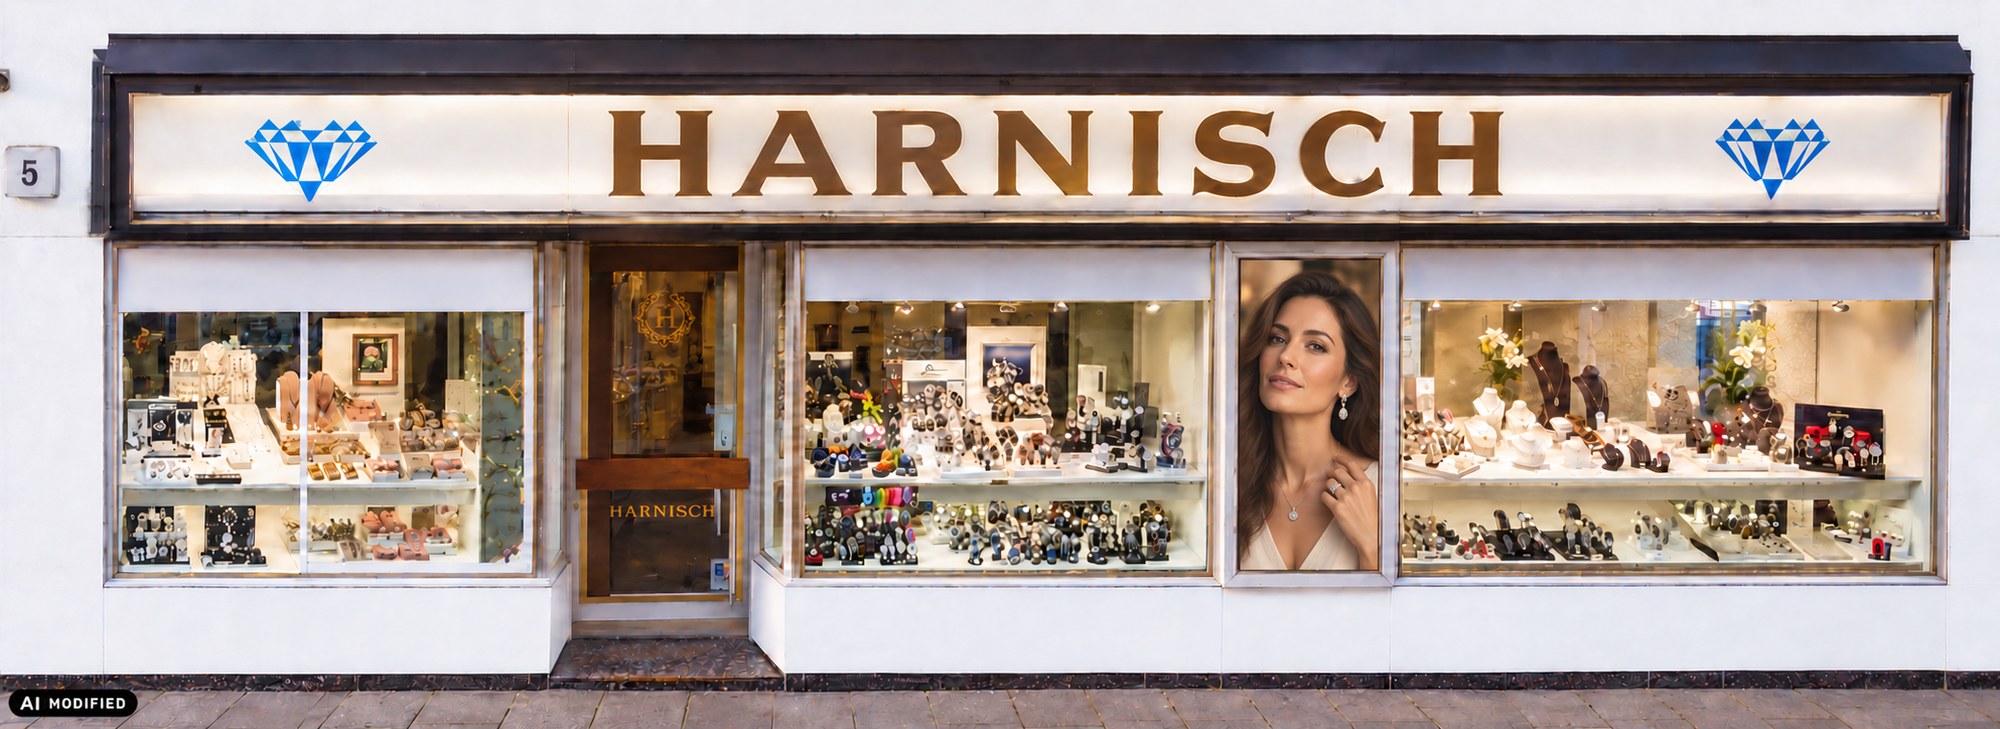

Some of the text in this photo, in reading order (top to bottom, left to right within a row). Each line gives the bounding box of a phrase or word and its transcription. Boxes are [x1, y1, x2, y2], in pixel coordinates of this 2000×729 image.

[608, 110, 1503, 198] HARNISCH
[22, 159, 38, 187] 5
[655, 304, 677, 329] H
[609, 504, 715, 518] HARNISCH
